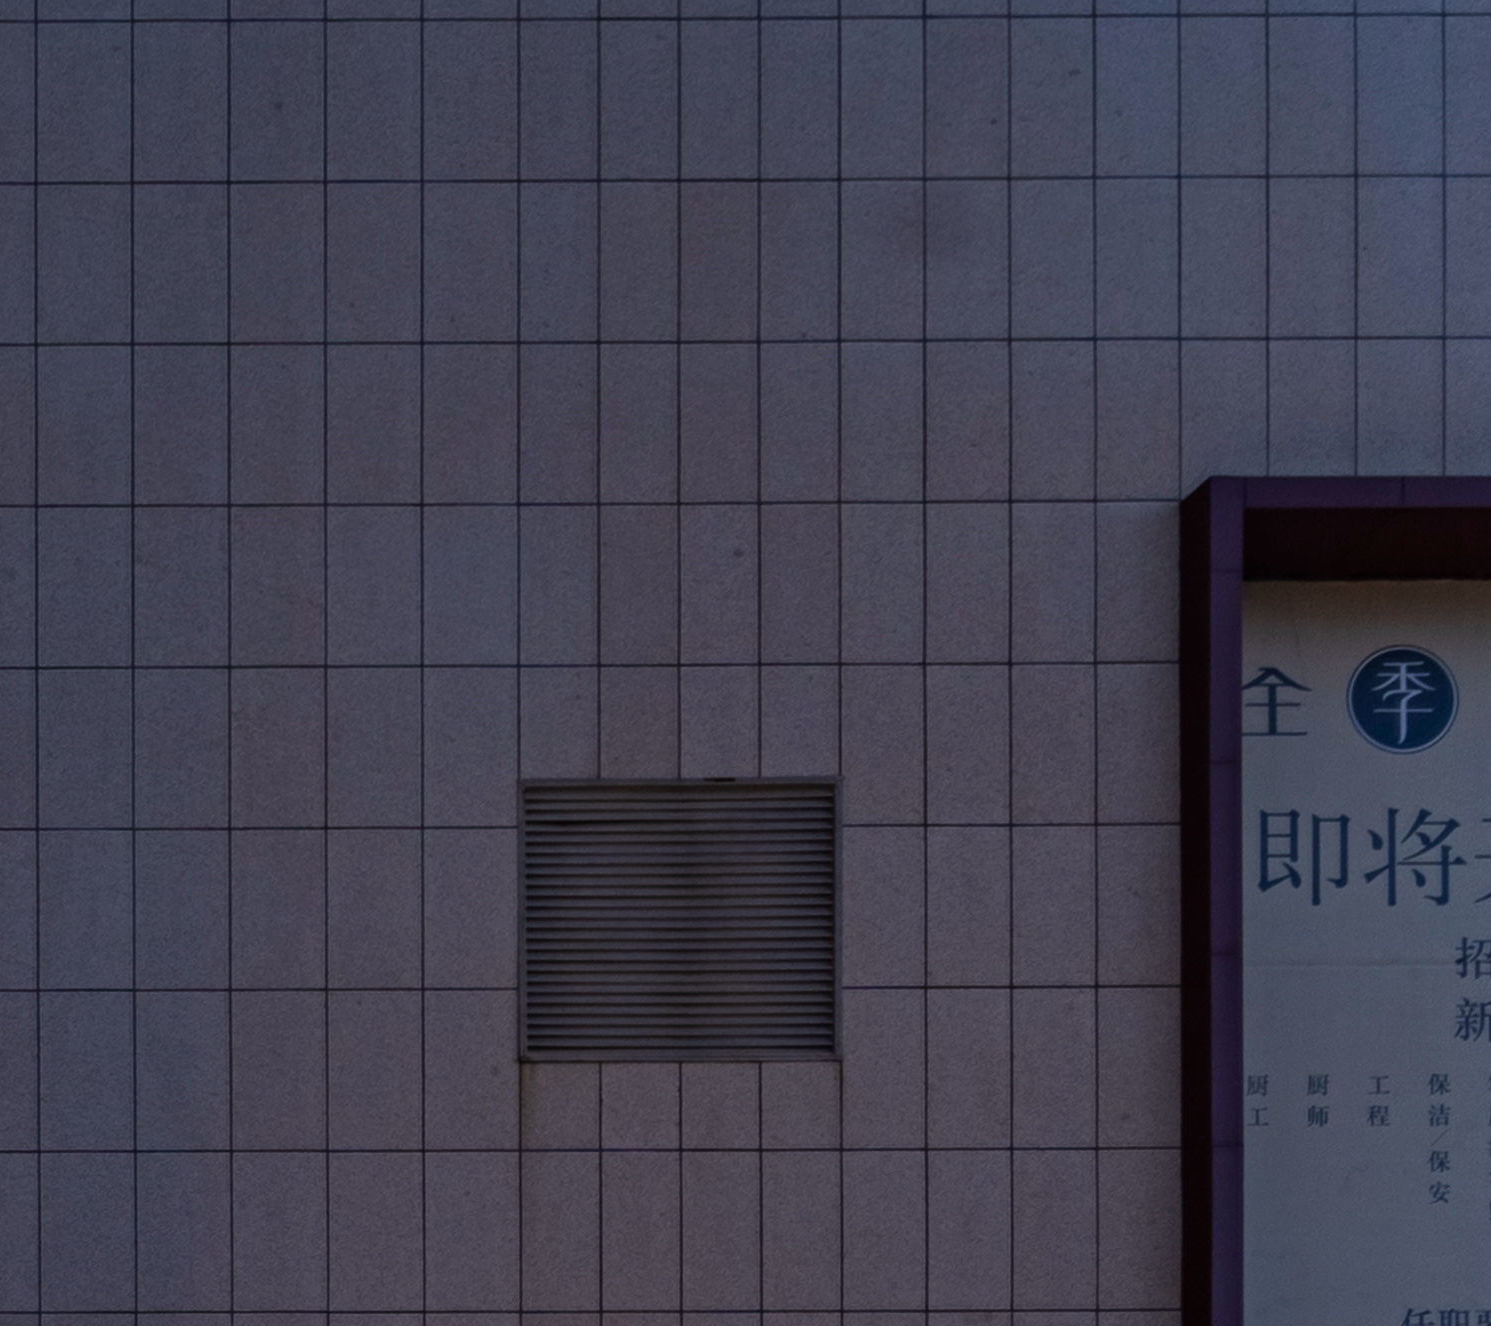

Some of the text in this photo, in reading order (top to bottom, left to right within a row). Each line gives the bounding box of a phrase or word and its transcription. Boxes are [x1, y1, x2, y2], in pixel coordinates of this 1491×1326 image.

[1257, 807, 1491, 907] 即将
[1246, 1073, 1270, 1128] 厨工
[1306, 1073, 1330, 1128] 厨师
[1366, 1074, 1391, 1128] 工程
